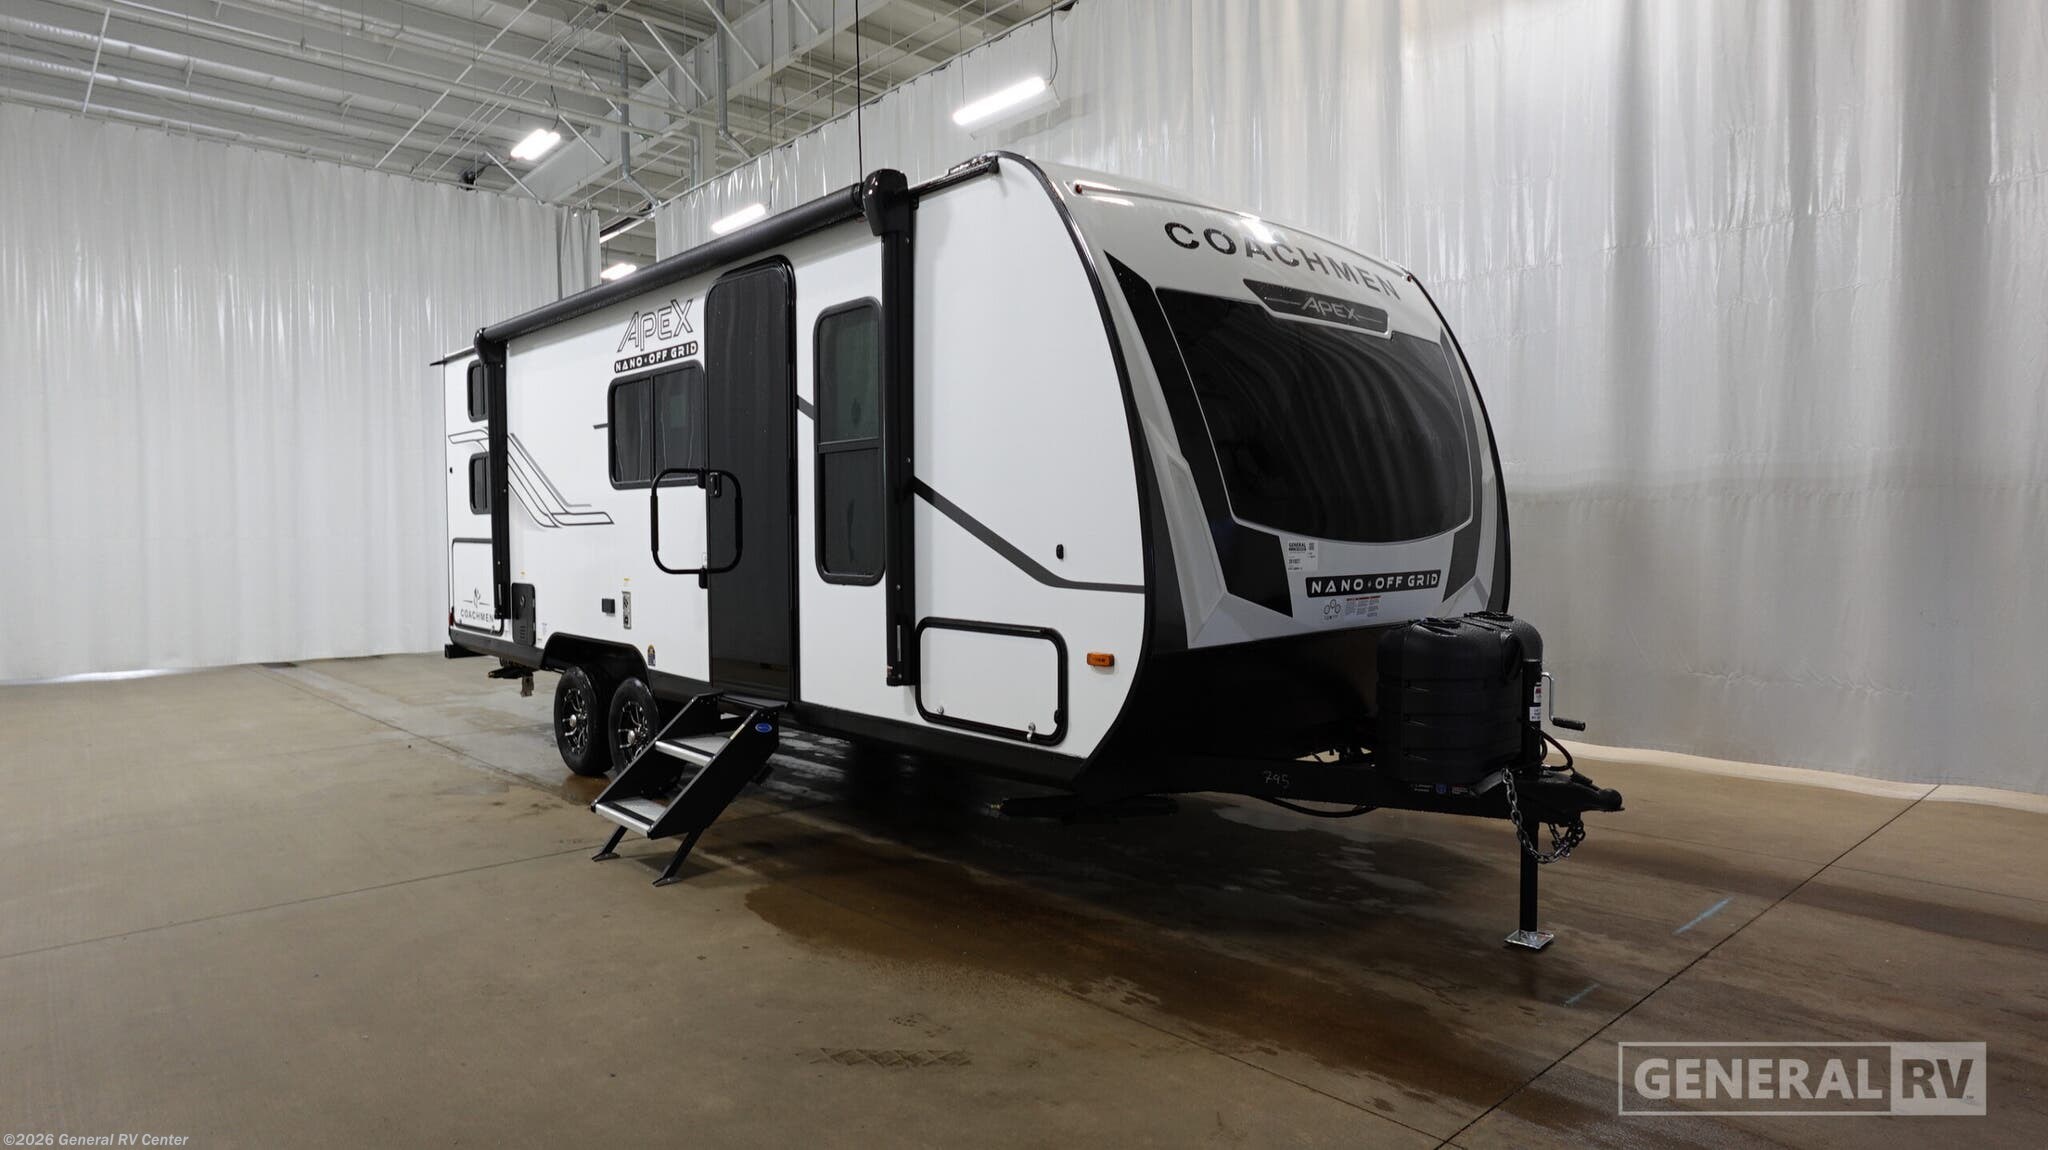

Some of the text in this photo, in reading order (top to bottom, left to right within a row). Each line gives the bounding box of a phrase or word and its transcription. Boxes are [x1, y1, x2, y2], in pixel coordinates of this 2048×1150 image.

[1164, 222, 1401, 300] COACHMEN
[1302, 296, 1359, 321] APEX
[617, 299, 694, 353] APEX
[671, 342, 698, 358] GRID
[1407, 573, 1438, 587] GRID
[460, 608, 494, 622] COACHMEN
